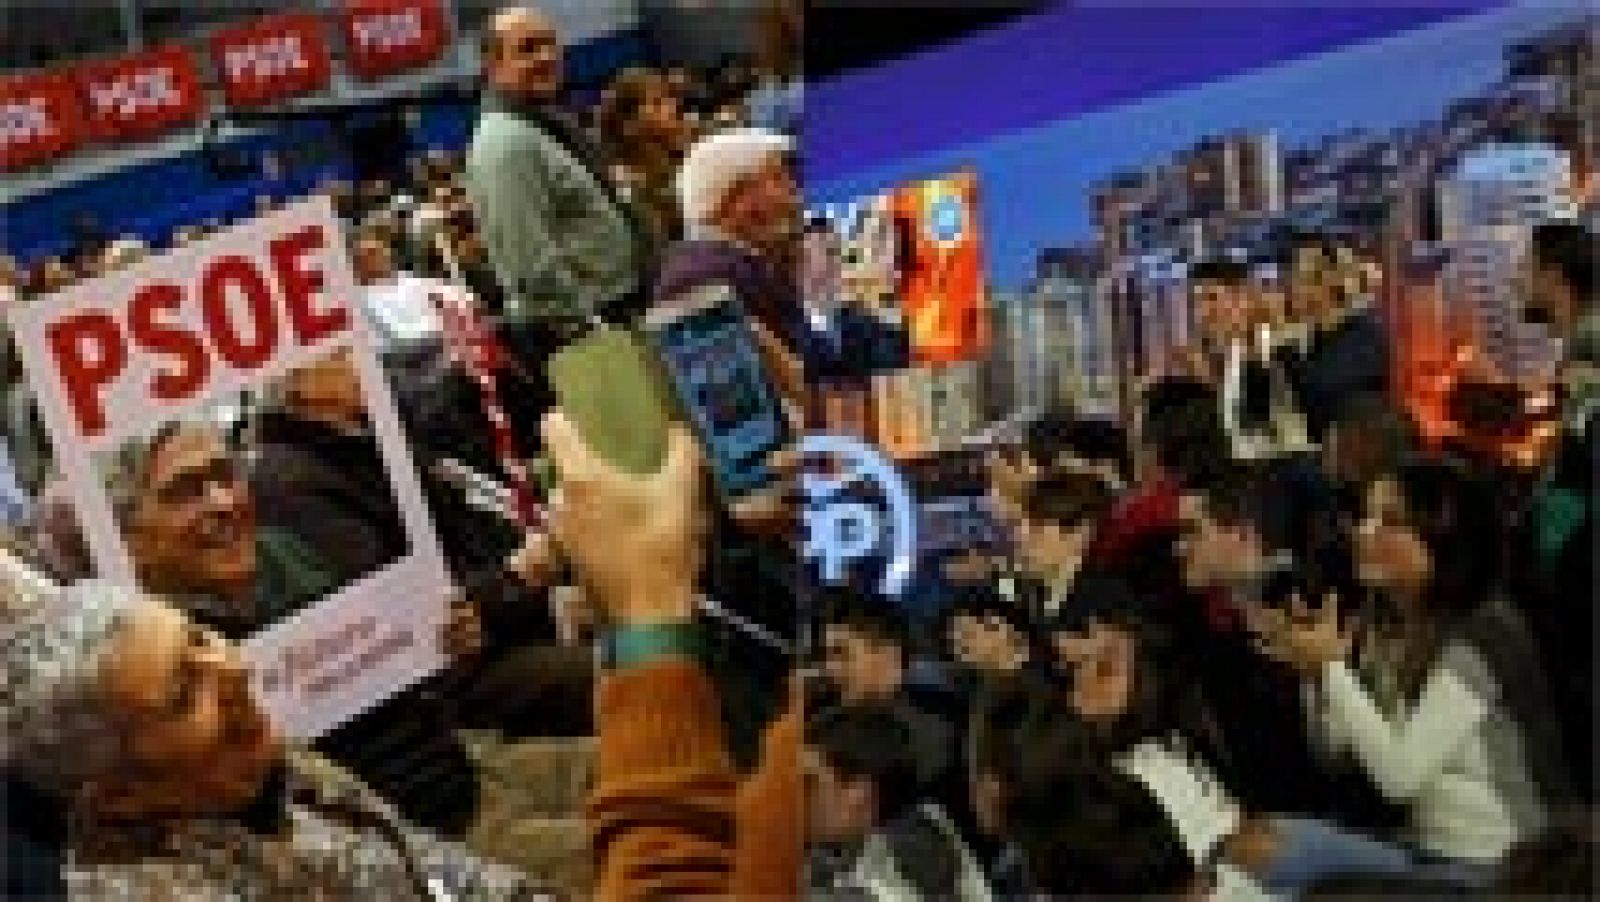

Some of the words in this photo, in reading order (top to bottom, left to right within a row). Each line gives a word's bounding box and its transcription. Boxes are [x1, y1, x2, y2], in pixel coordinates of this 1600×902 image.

[223, 36, 309, 84] PSOE
[88, 67, 182, 114] PSOE
[45, 225, 349, 436] PSOE
